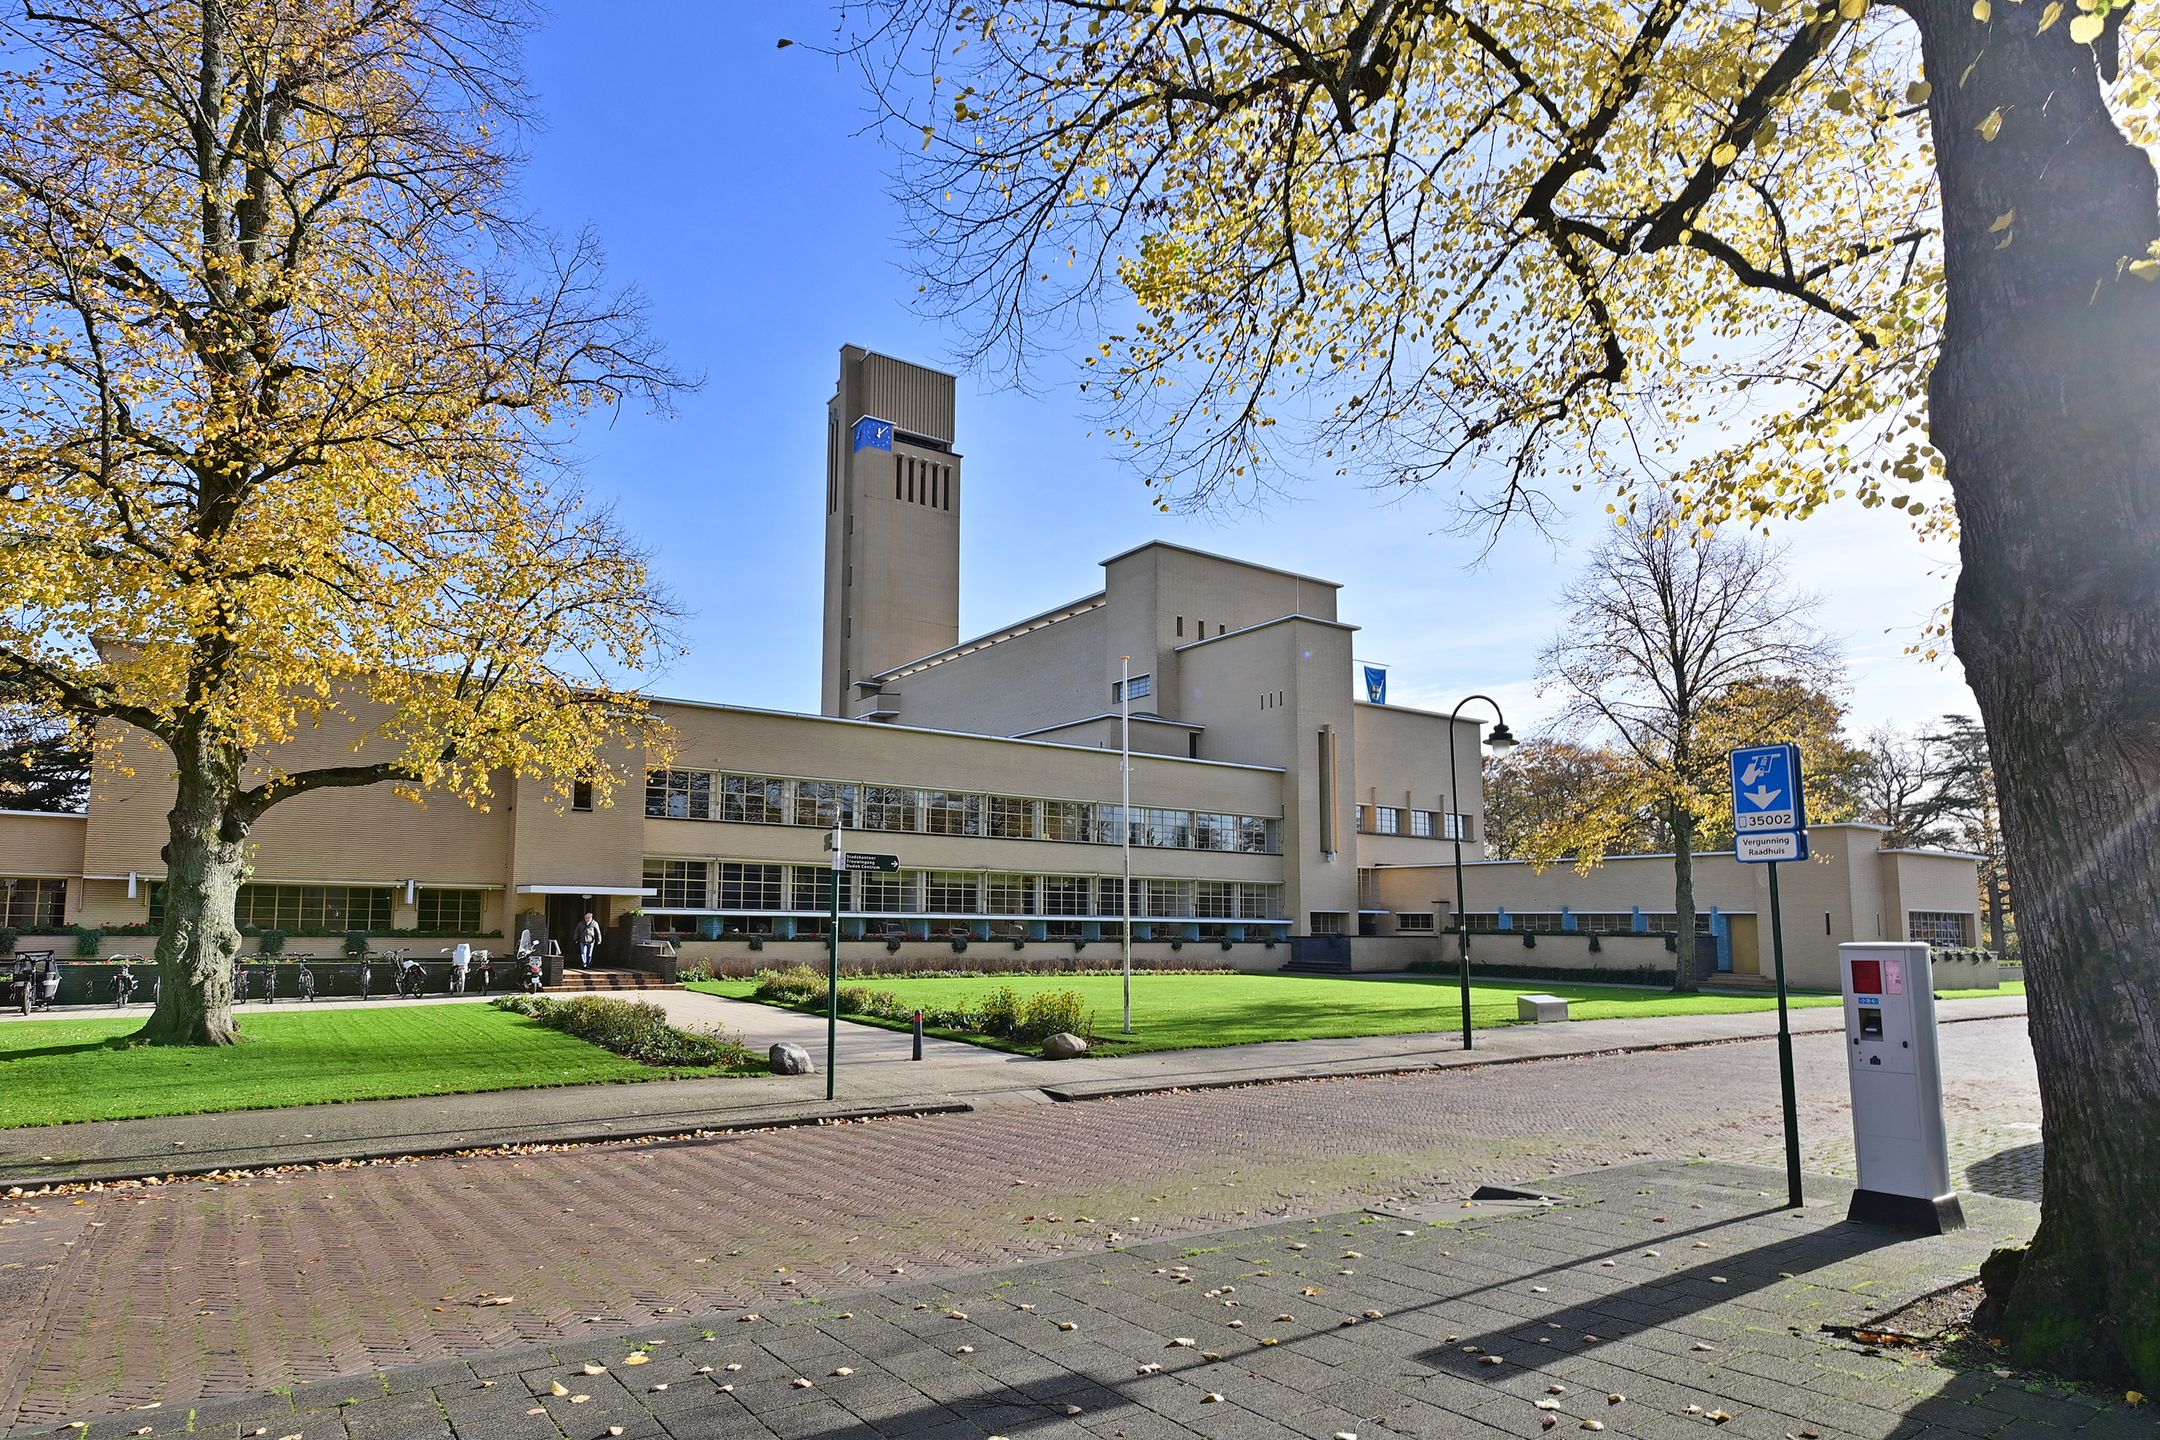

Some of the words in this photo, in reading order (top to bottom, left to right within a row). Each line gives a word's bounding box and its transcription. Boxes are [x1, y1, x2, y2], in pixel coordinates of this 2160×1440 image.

[1749, 814, 1791, 827] 35002
[1742, 837, 1790, 847] Vergunning
[1748, 847, 1785, 856] Raadhuis
